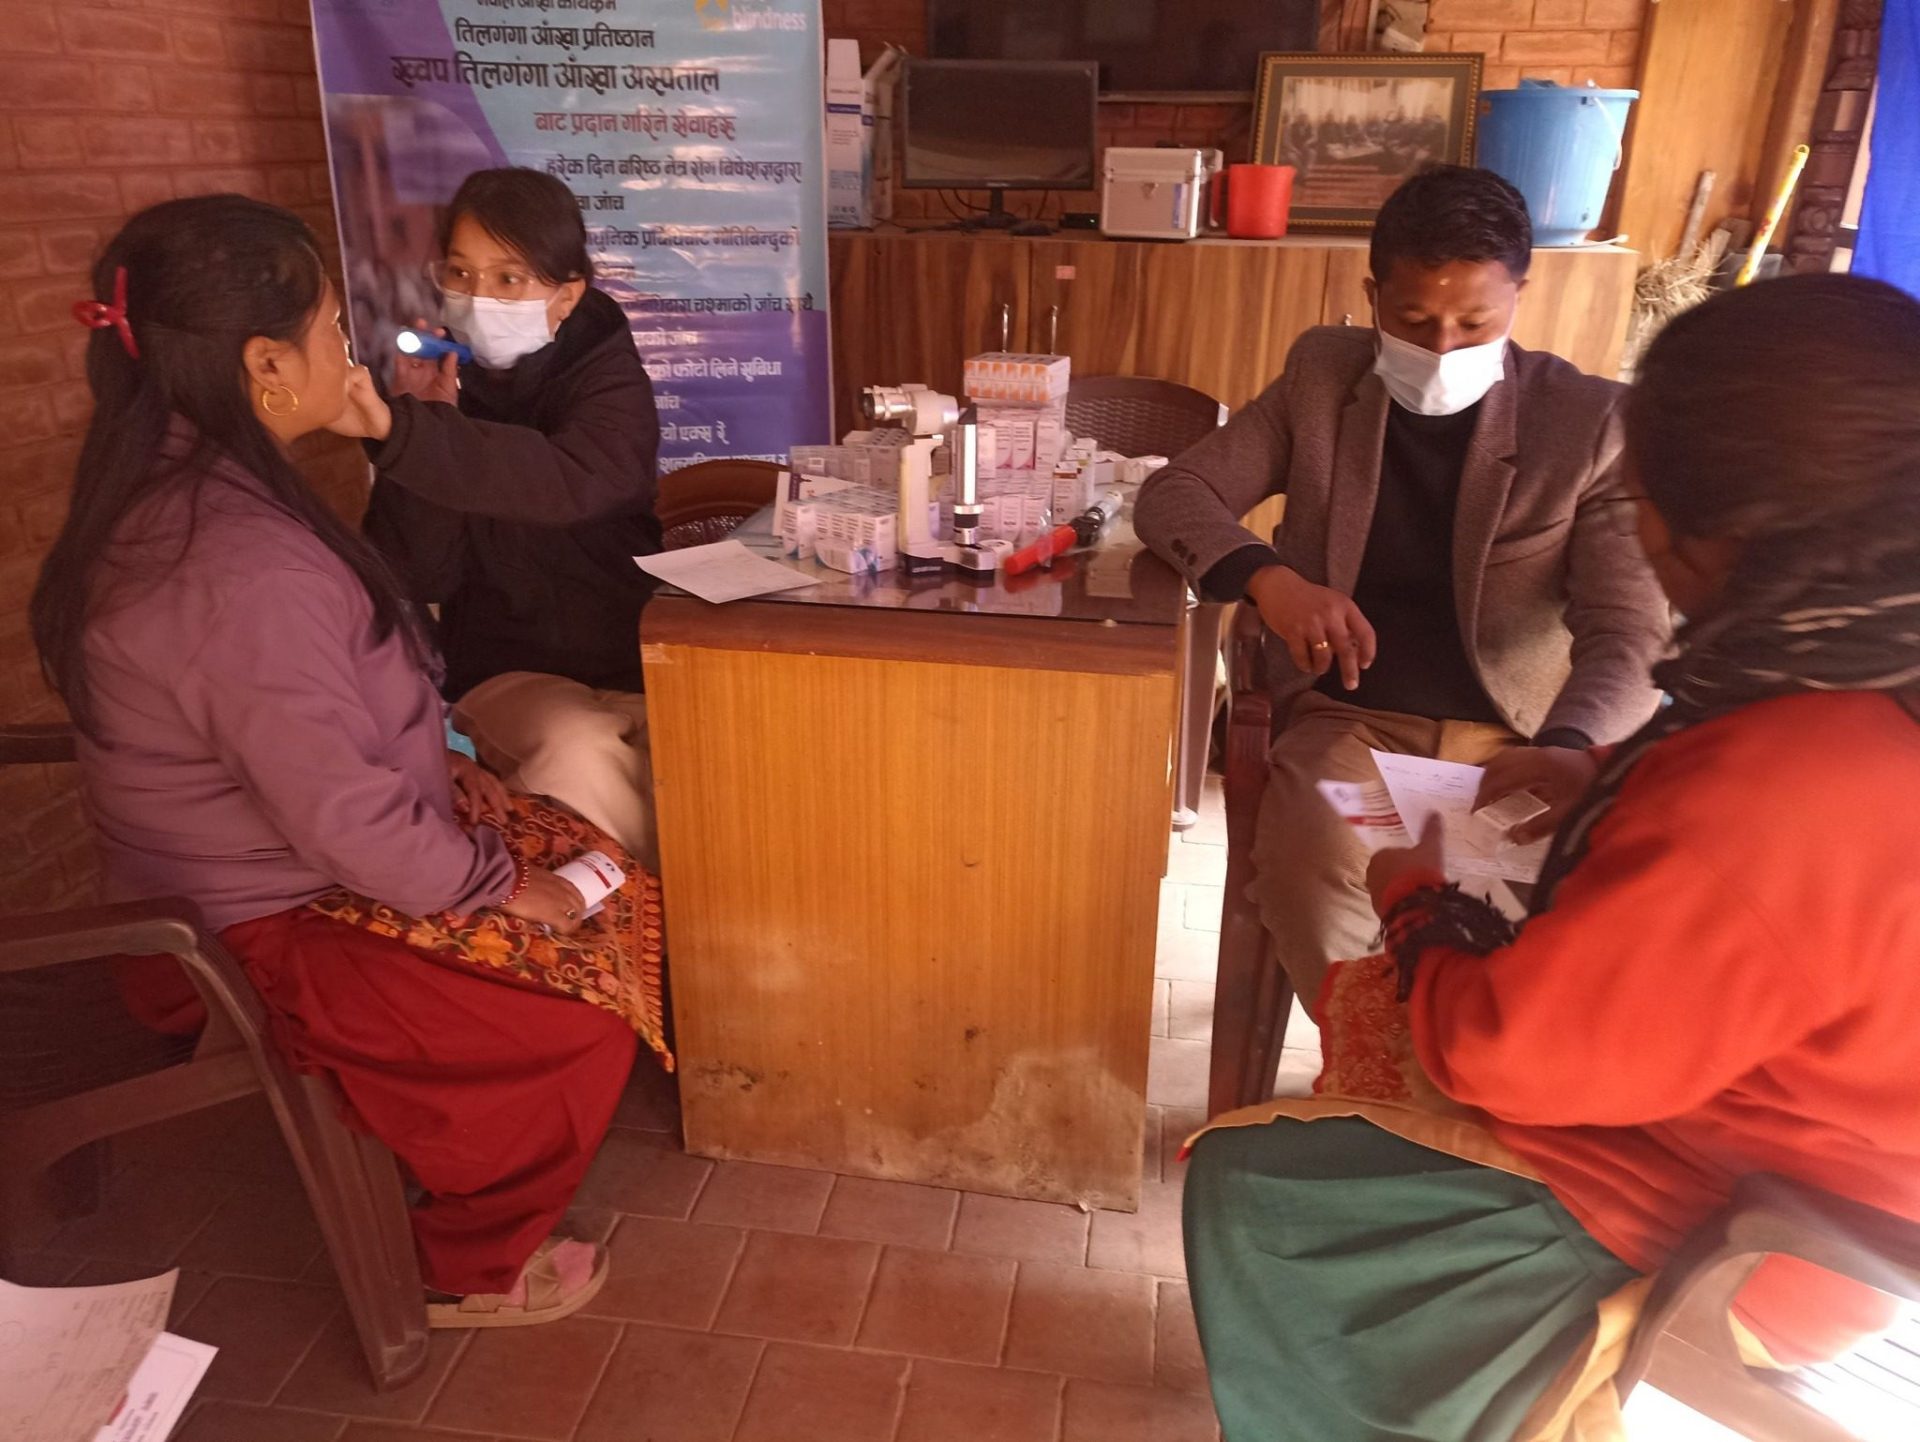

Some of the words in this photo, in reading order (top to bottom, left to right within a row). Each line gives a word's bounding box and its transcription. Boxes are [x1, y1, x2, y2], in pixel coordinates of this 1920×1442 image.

[455, 17, 527, 46] तिलगंगा
[583, 22, 655, 50] प्रतिष्ठान
[455, 51, 549, 89] तिलगंगा
[622, 64, 720, 97] अस्पताल
[587, 154, 614, 179] दिन
